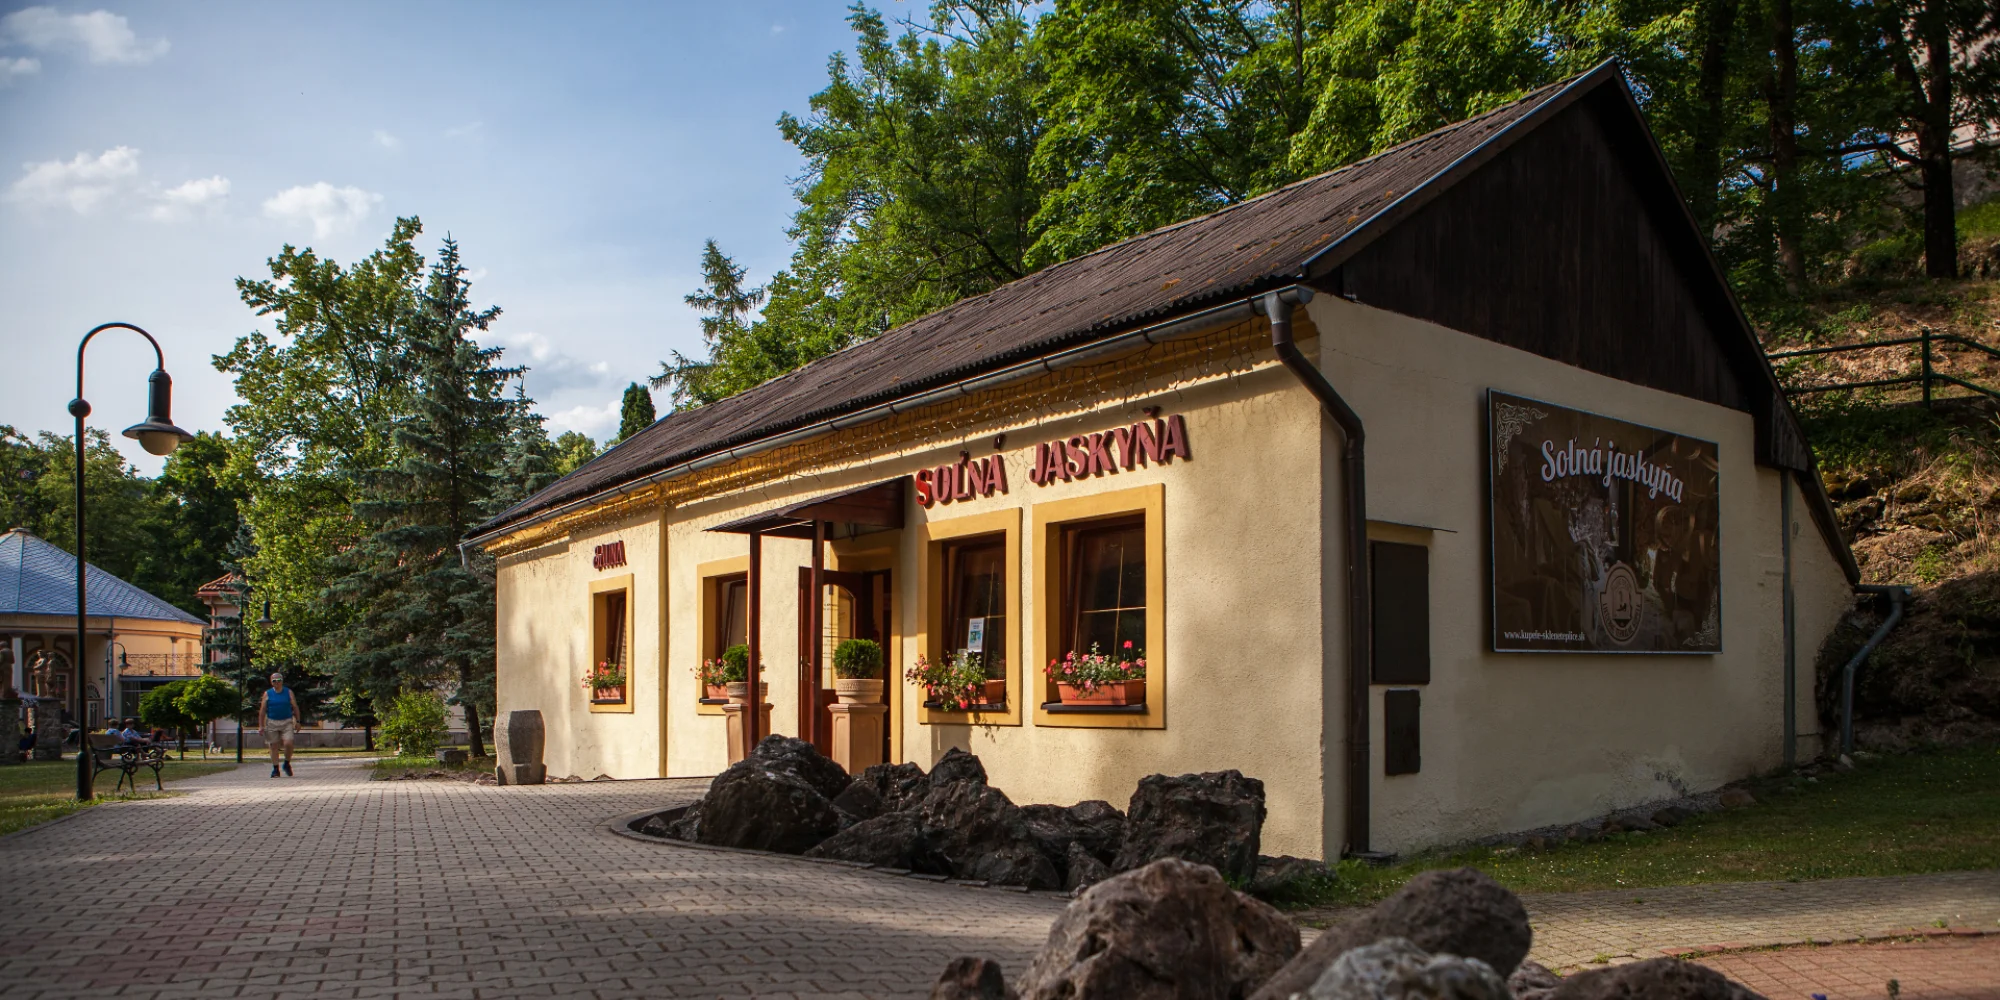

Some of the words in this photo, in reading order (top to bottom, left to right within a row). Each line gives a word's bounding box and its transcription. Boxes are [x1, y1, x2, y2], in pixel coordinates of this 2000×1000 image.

[915, 432, 1009, 508] SOĽNÁ
[1029, 406, 1190, 487] JASKYŇA
[1541, 437, 1602, 481] Soľná
[1603, 440, 1684, 503] jaskyňa
